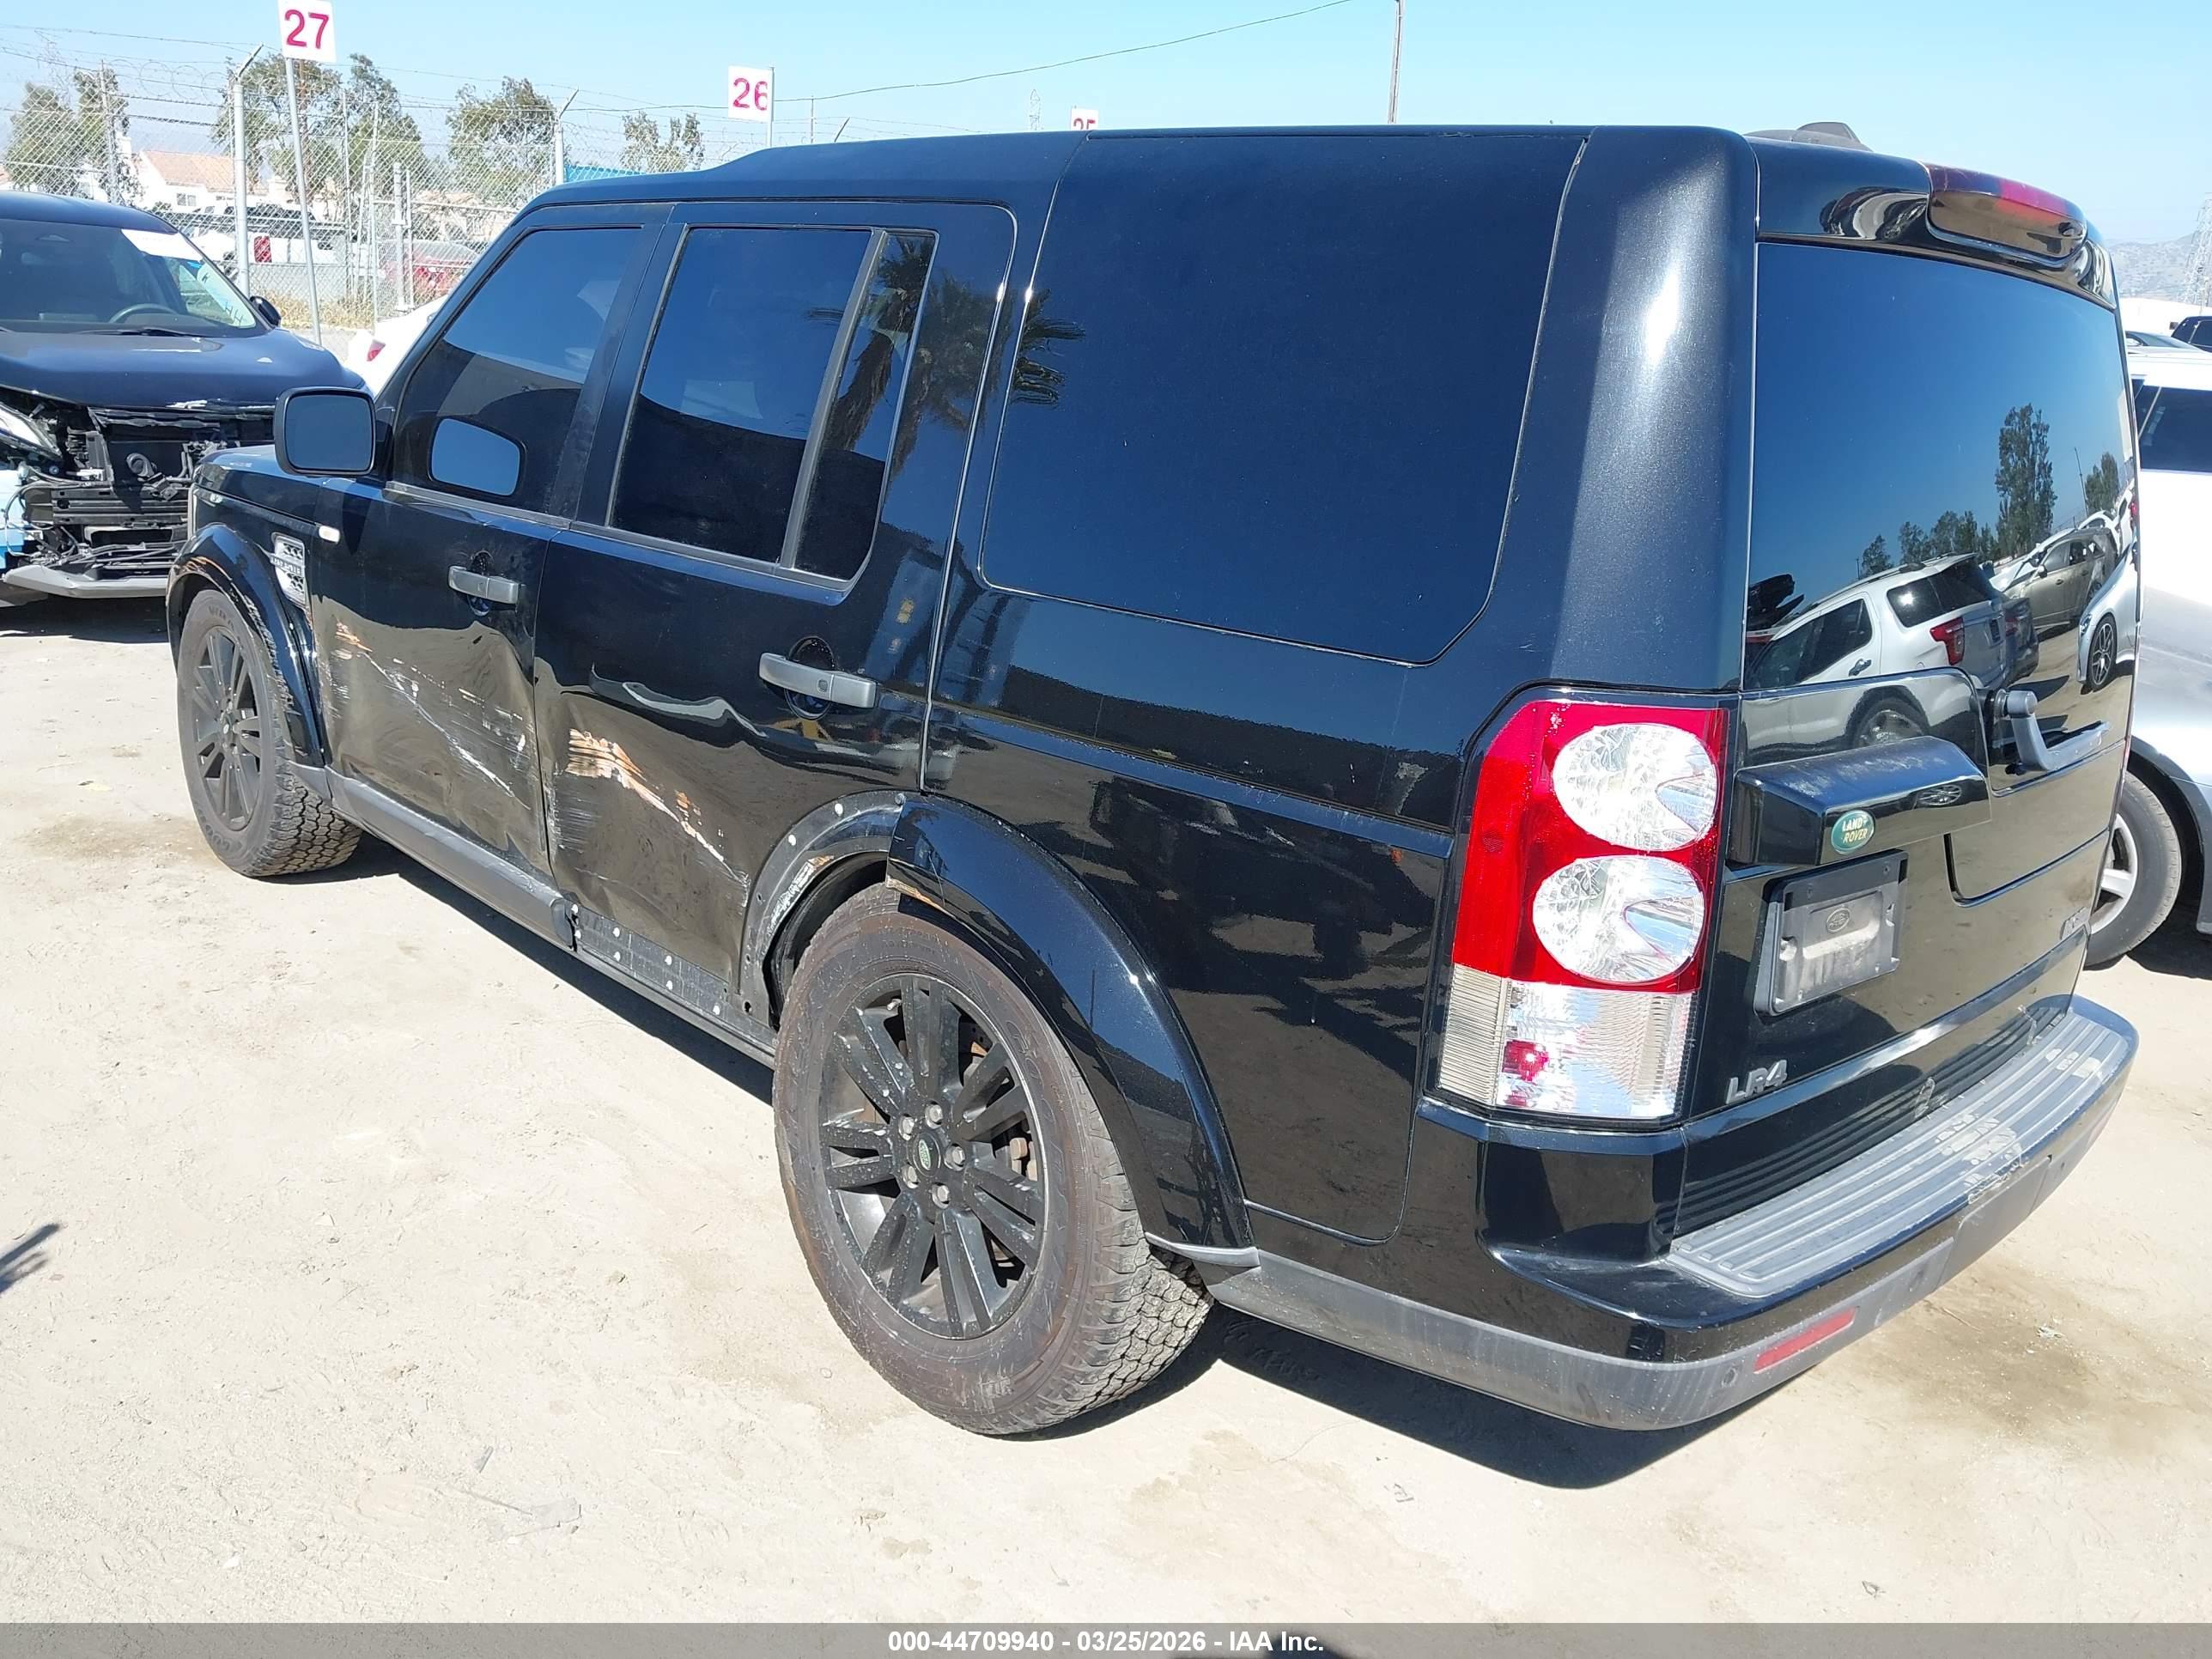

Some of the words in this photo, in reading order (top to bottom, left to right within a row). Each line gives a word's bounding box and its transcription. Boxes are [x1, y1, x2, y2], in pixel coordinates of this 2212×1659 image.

[284, 9, 329, 49] 27
[733, 77, 768, 111] 26
[1842, 817, 1863, 832] LAND
[1842, 829, 1868, 843] ROVER
[1726, 1060, 1788, 1104] LR4
